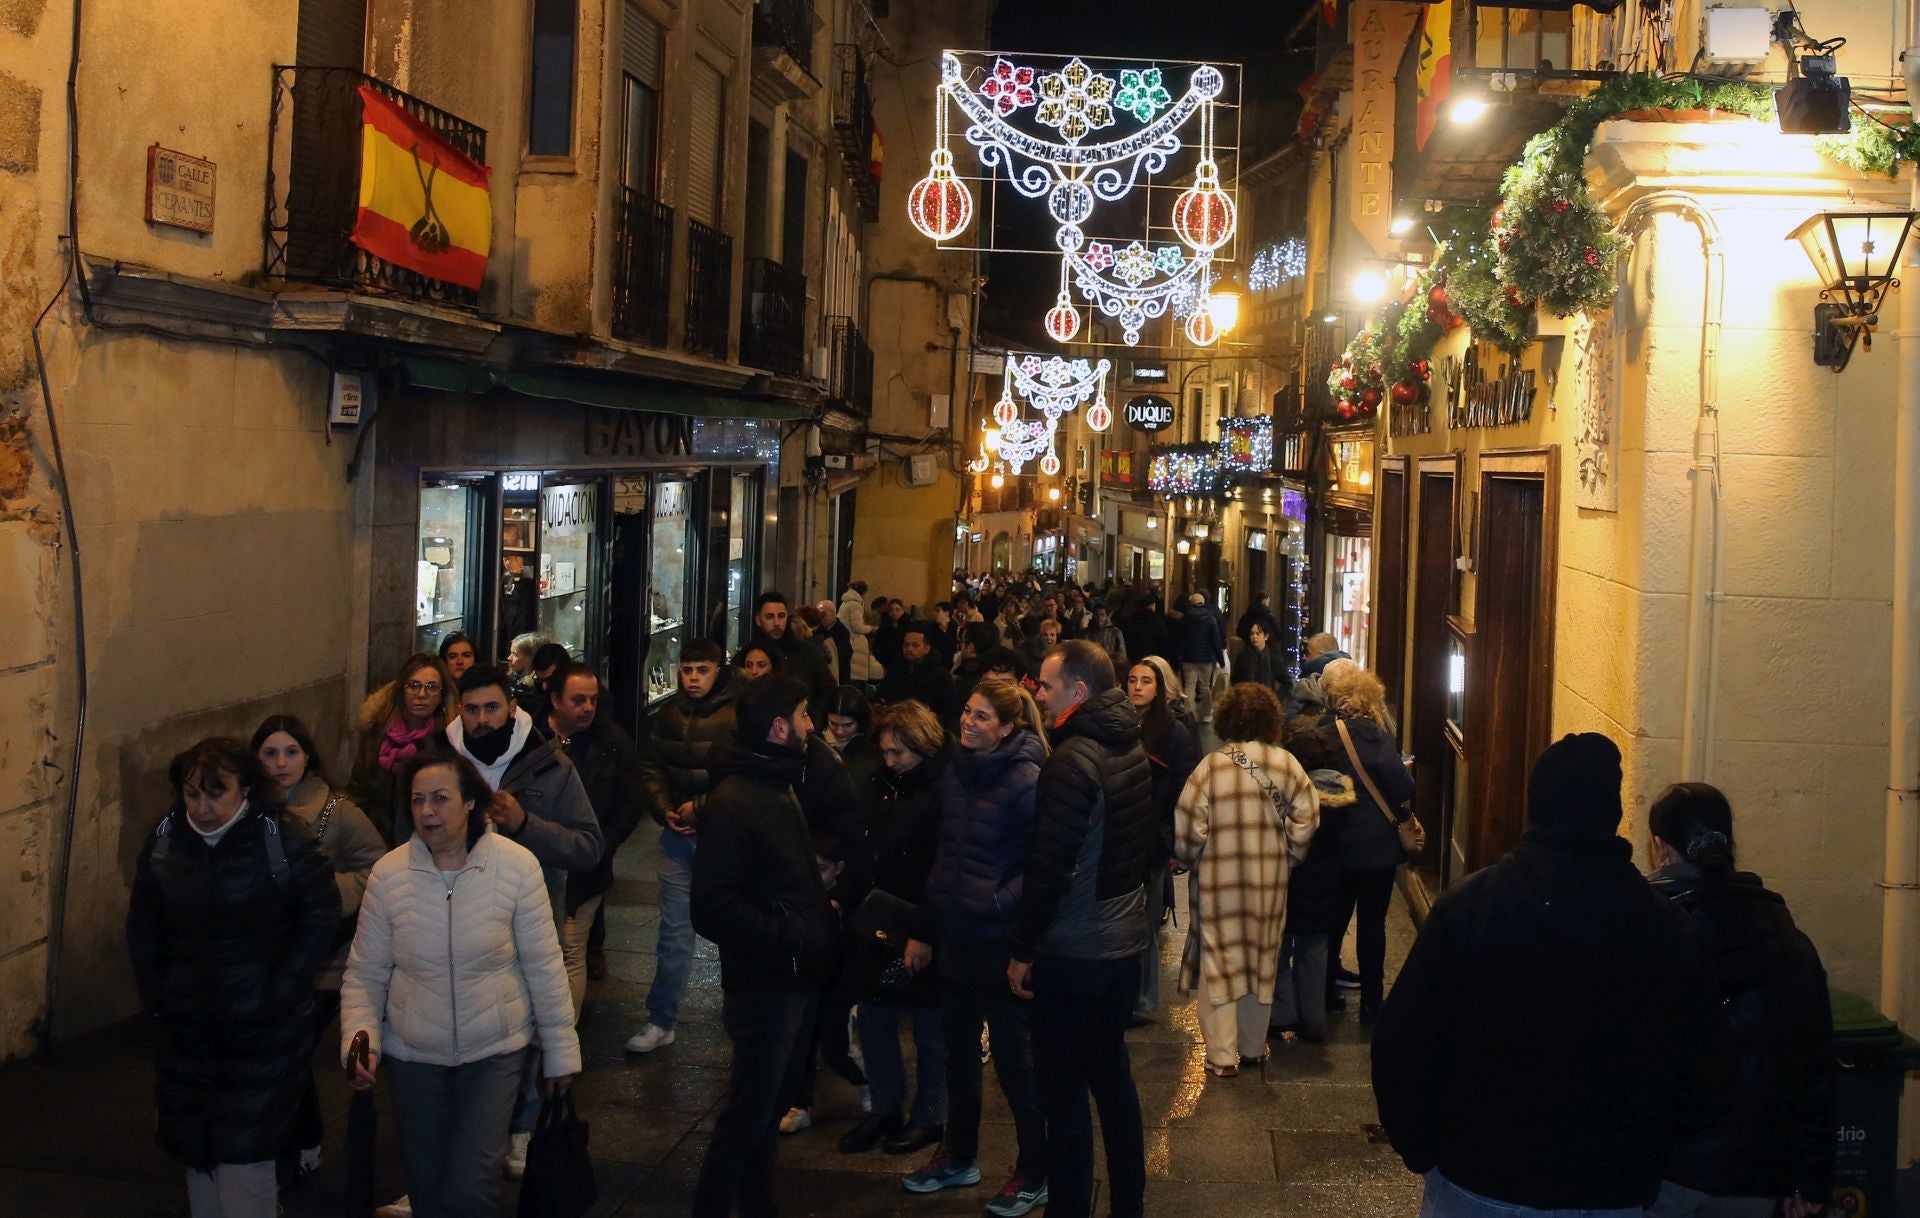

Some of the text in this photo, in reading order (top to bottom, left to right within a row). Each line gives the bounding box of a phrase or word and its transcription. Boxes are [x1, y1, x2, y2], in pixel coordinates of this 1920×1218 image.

[178, 165, 209, 184] CALLE
[159, 191, 212, 218] CERVANTES
[1128, 405, 1172, 423] DUQUE
